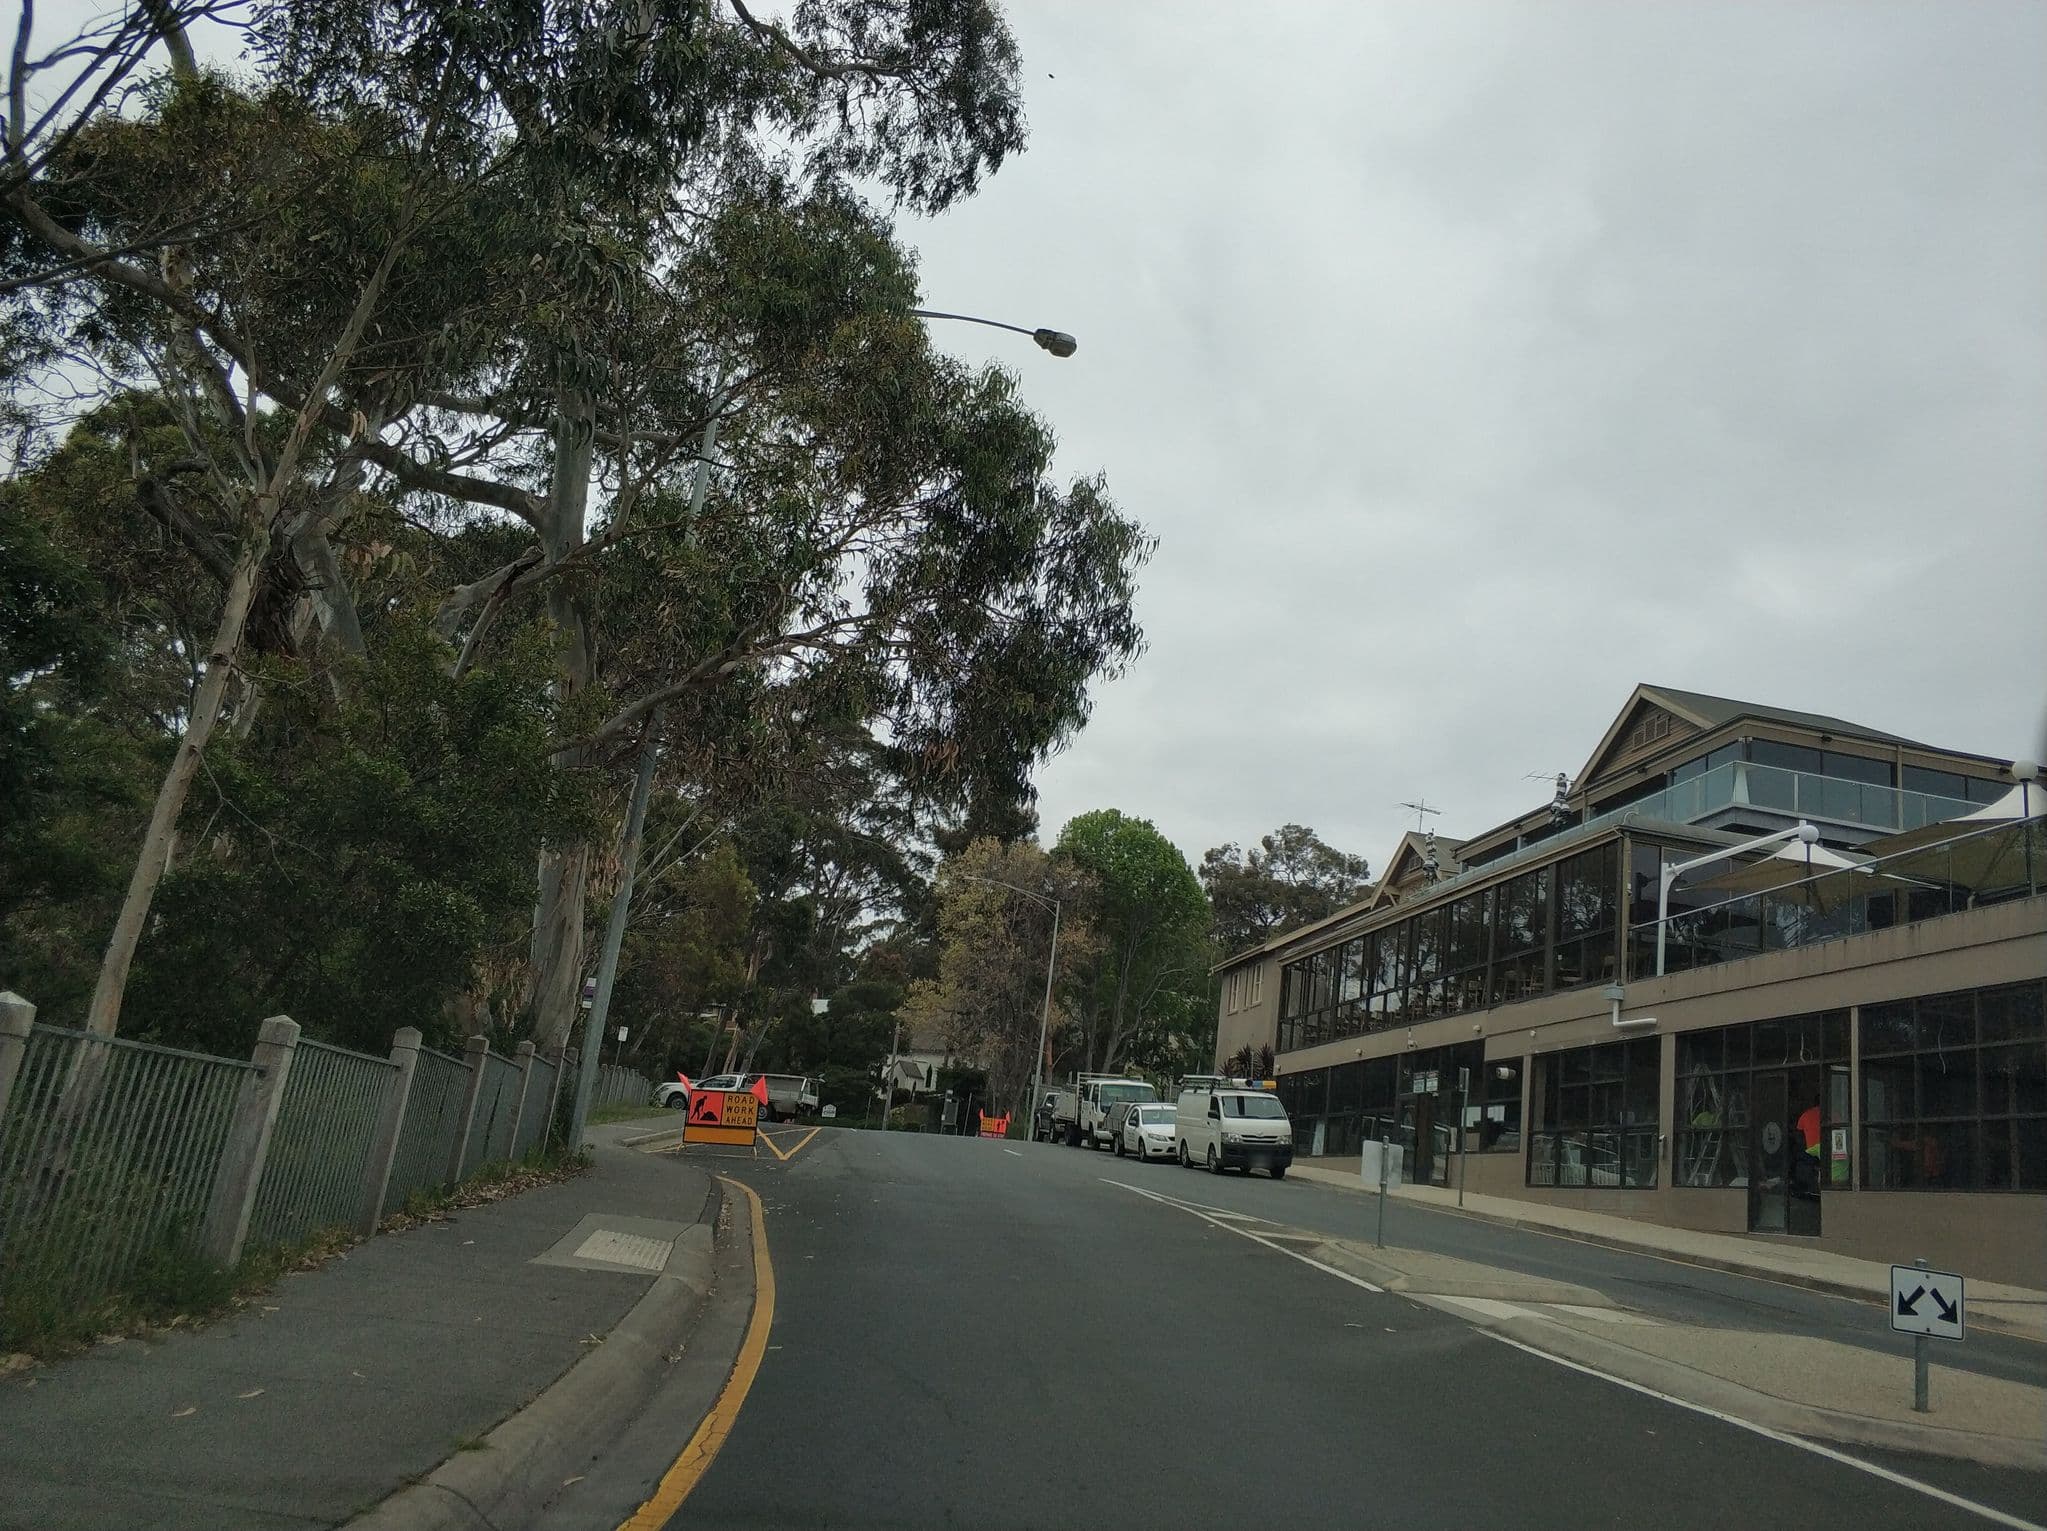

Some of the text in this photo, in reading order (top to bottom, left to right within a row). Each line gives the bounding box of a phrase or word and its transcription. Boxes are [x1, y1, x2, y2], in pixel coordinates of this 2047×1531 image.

[728, 1095, 755, 1104] ROAD
[726, 1105, 754, 1115] WORK
[726, 1116, 753, 1125] AHEAD
